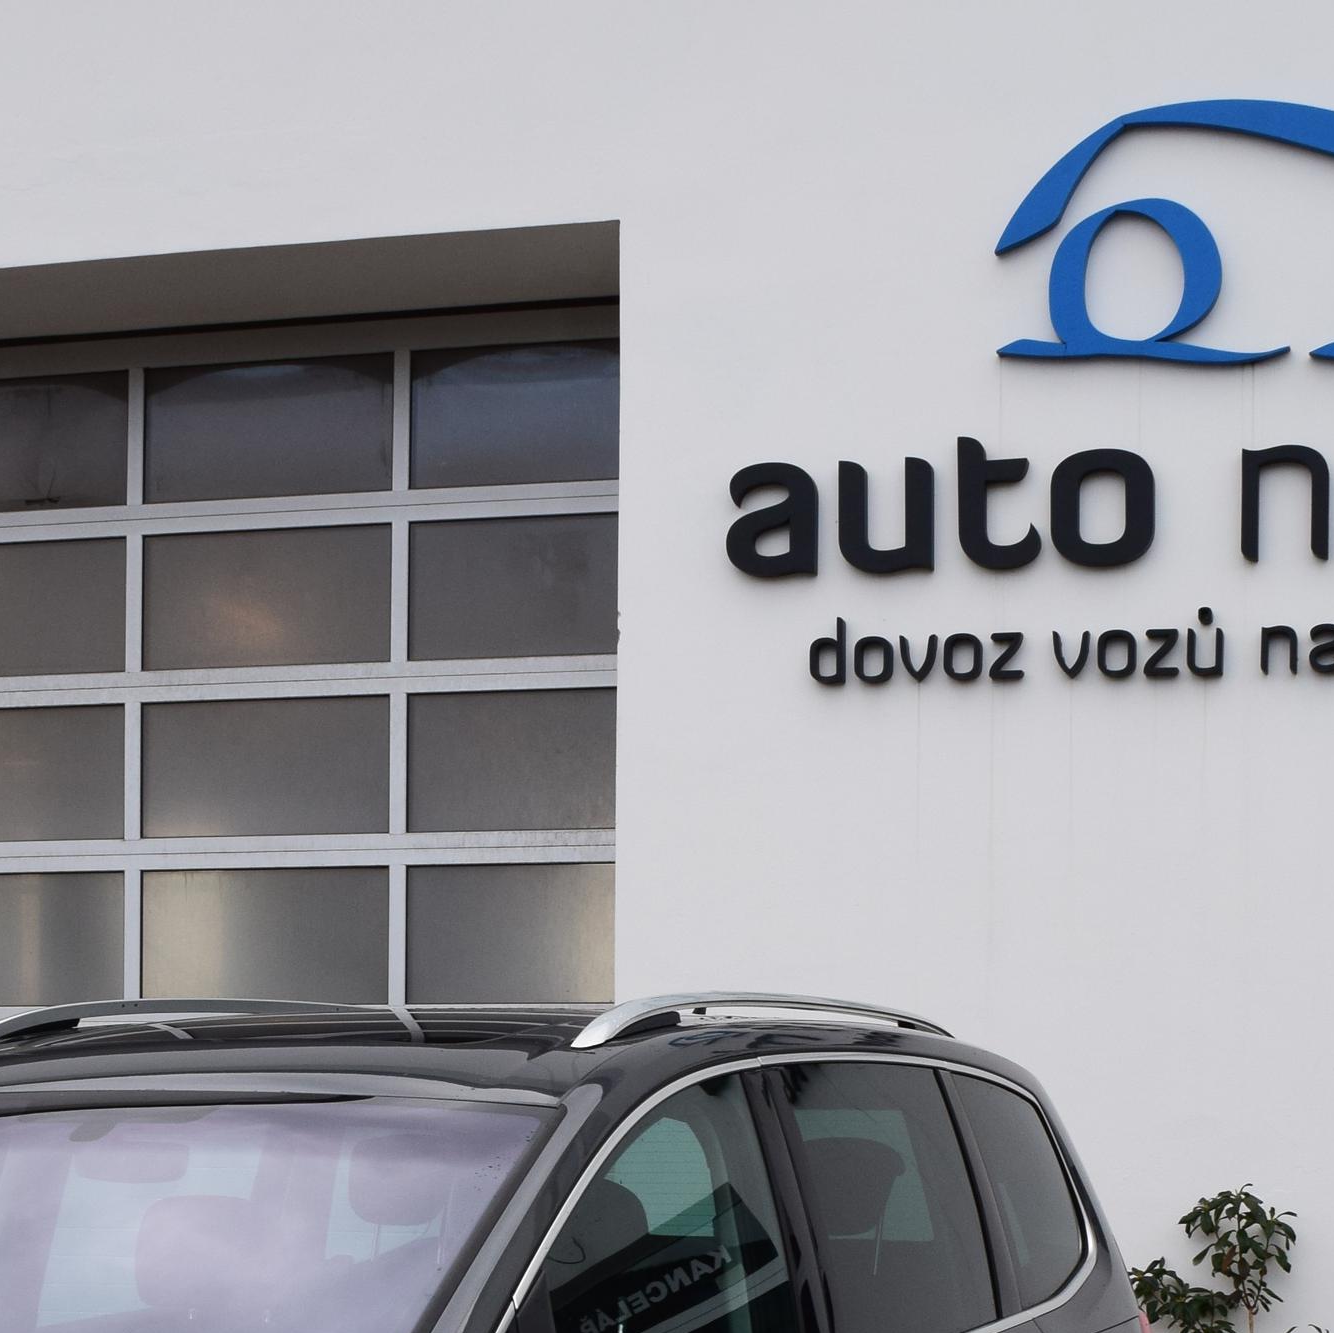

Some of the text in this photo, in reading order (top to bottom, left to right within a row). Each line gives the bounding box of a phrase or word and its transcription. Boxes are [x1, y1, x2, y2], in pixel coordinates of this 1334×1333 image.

[726, 436, 1156, 579] auto
[810, 616, 1025, 689] dovoz
[1052, 607, 1225, 682] vozů
